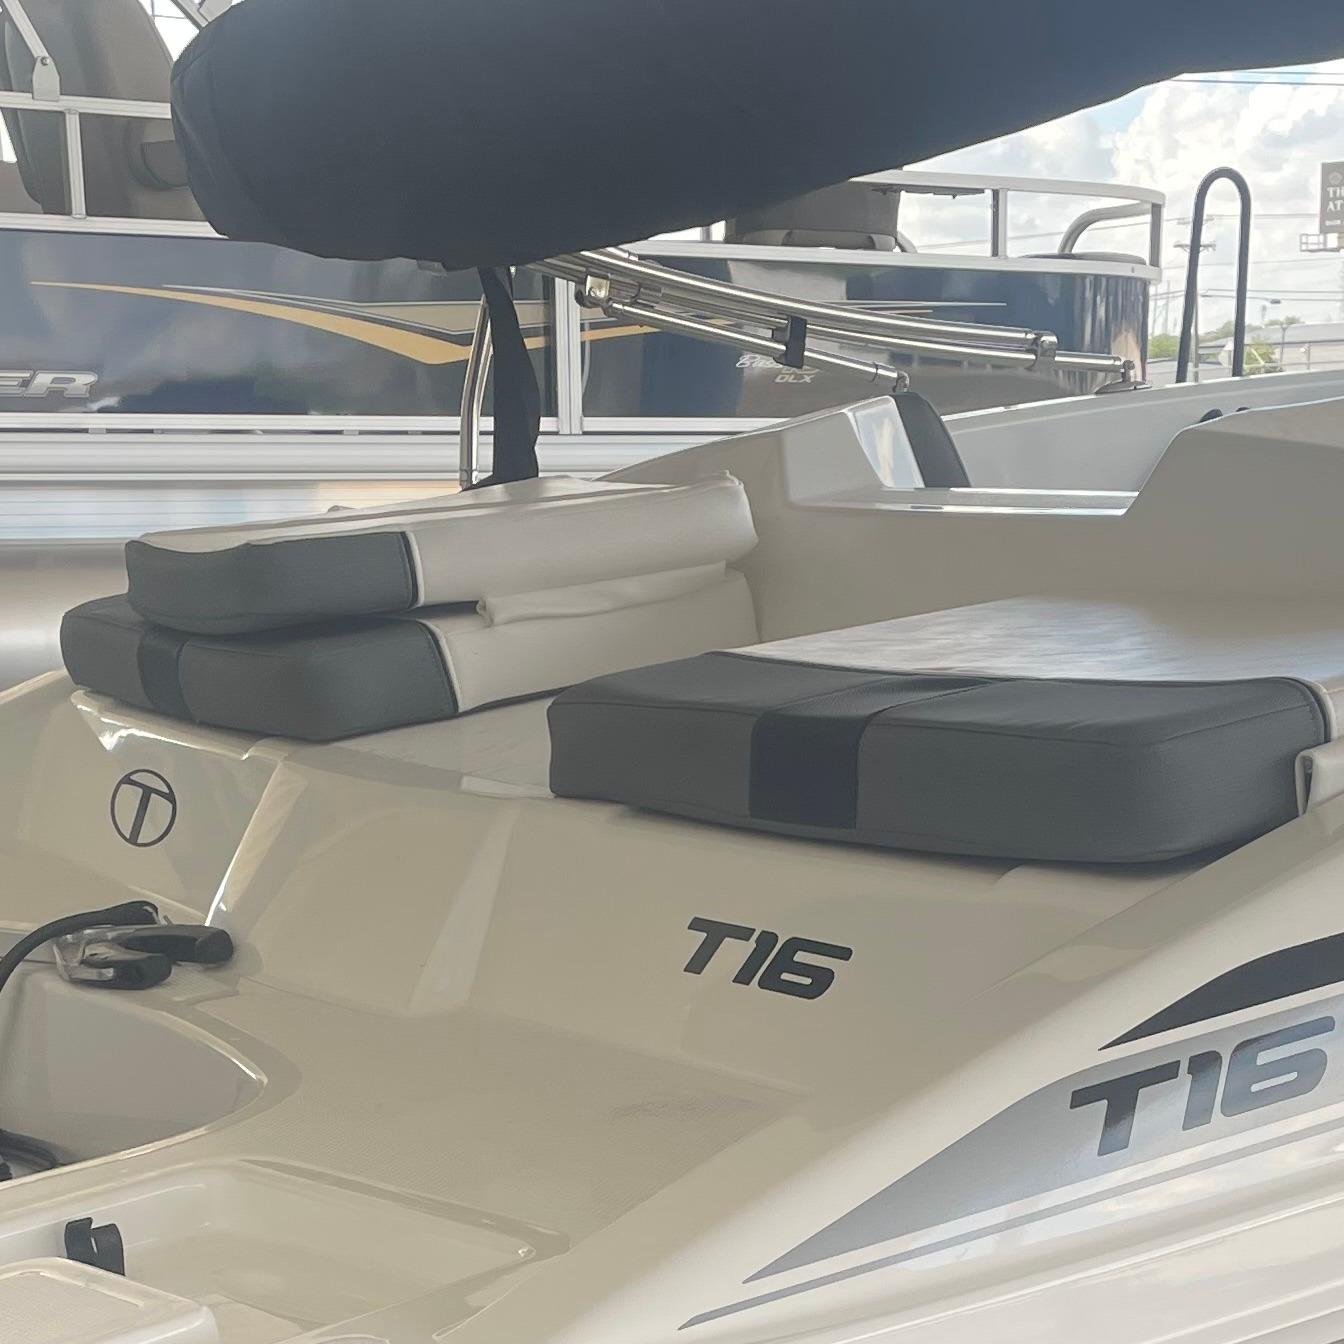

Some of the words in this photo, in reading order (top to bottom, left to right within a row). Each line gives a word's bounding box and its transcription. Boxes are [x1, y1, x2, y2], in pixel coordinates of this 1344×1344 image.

[1327, 200, 1344, 212] AT
[775, 374, 815, 383] DLX
[683, 916, 853, 1000] T16
[1069, 1016, 1336, 1157] T16
